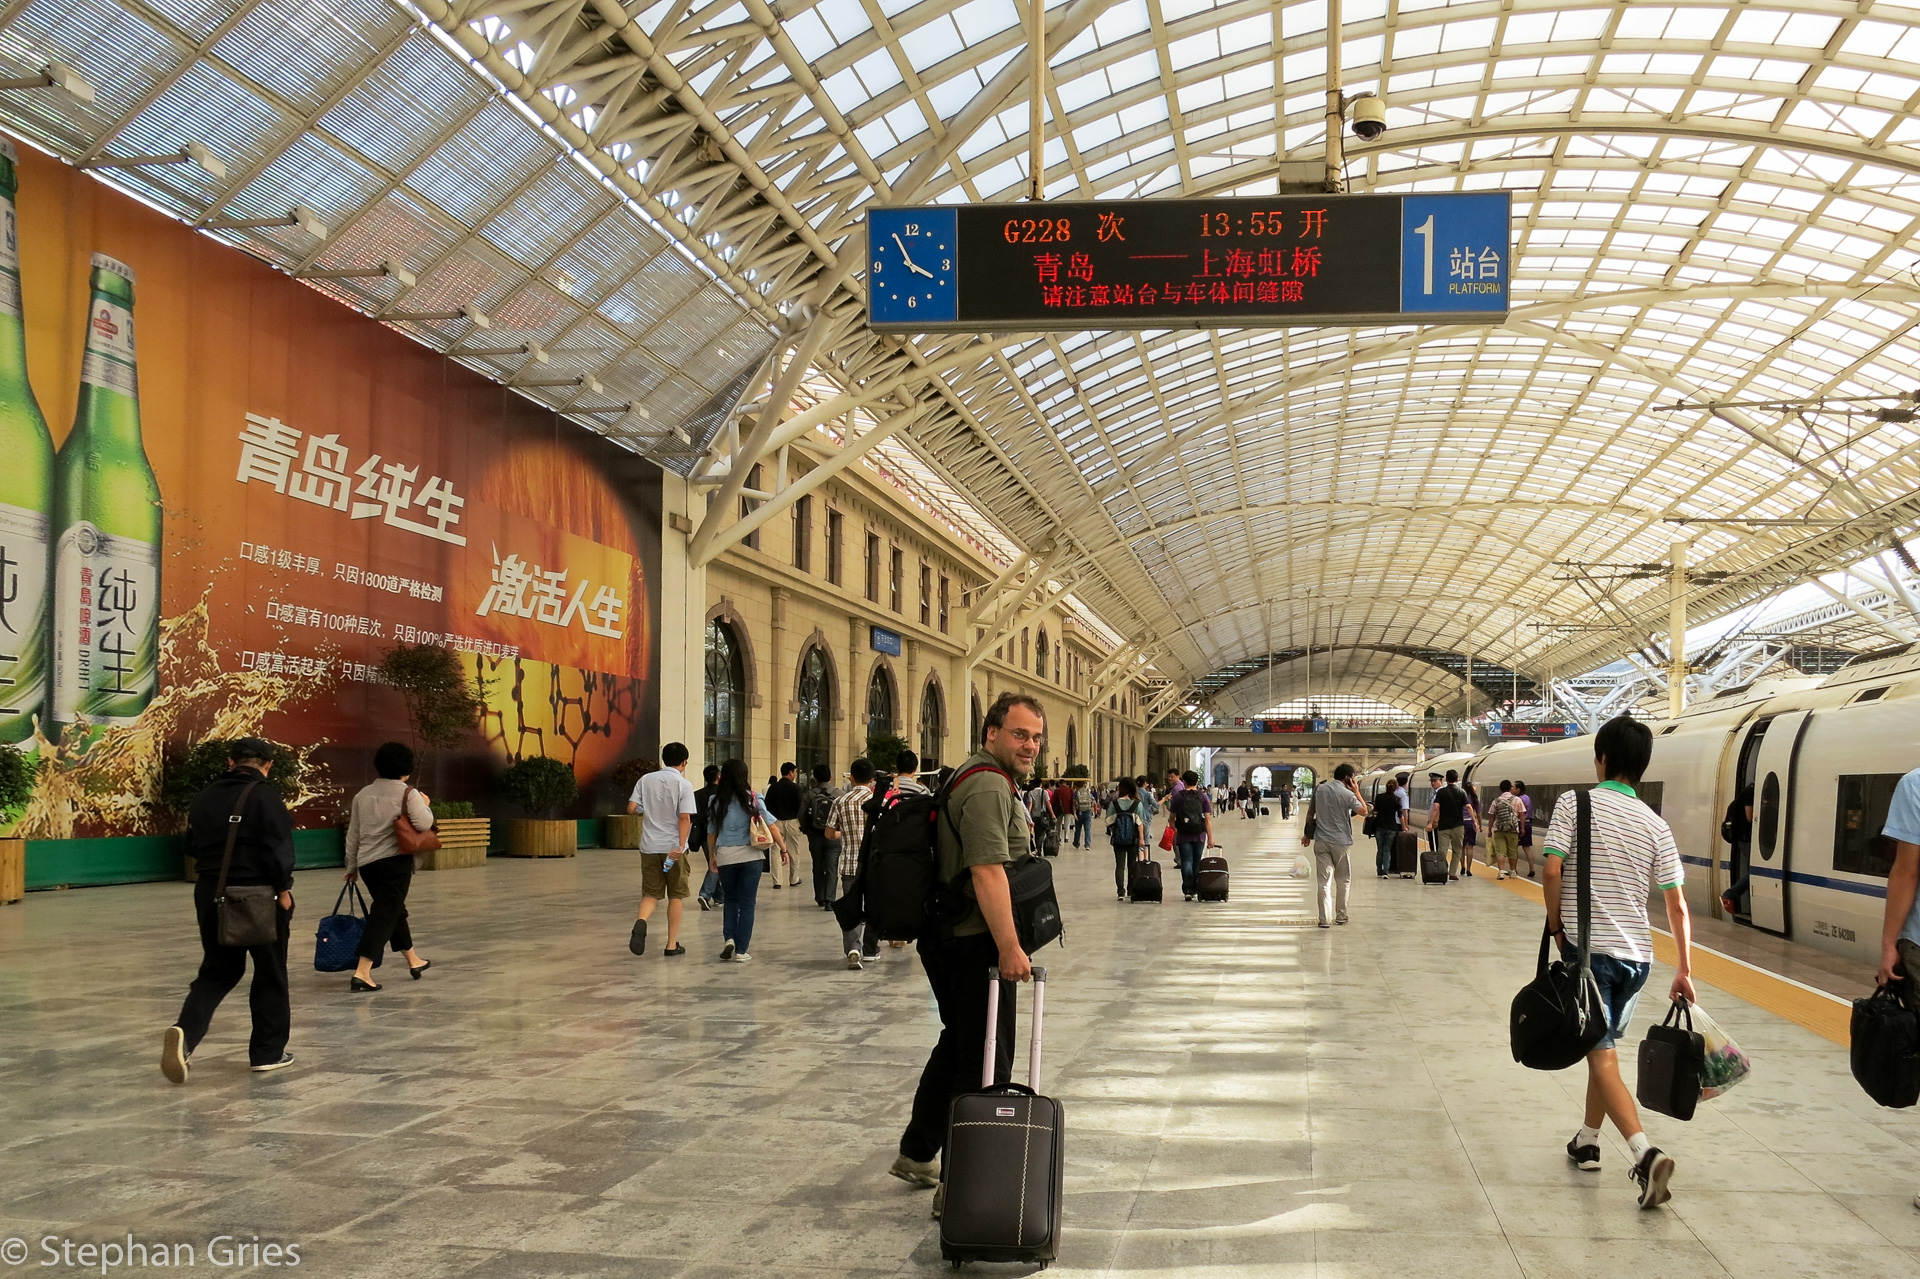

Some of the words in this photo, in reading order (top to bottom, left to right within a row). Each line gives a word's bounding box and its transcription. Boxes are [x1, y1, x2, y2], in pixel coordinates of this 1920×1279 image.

[904, 223, 919, 237] 12
[1004, 218, 1071, 243] G228
[1097, 212, 1126, 243] 次
[1200, 211, 1283, 238] 13:55
[1299, 209, 1329, 239] 开
[874, 261, 882, 273] 9
[942, 259, 950, 271] 3
[1034, 251, 1095, 283] 青岛
[1192, 246, 1322, 280] 上海虹桥
[1414, 214, 1435, 295] 1
[1450, 246, 1501, 279] 站台
[908, 296, 916, 308] 6
[1042, 280, 1305, 308] 请注意站台与车体间缝隙
[1449, 282, 1501, 294] PLATFORM
[236, 411, 467, 547] 青岛纯生
[475, 539, 623, 640] 激活人生
[97, 567, 138, 695] 纯生
